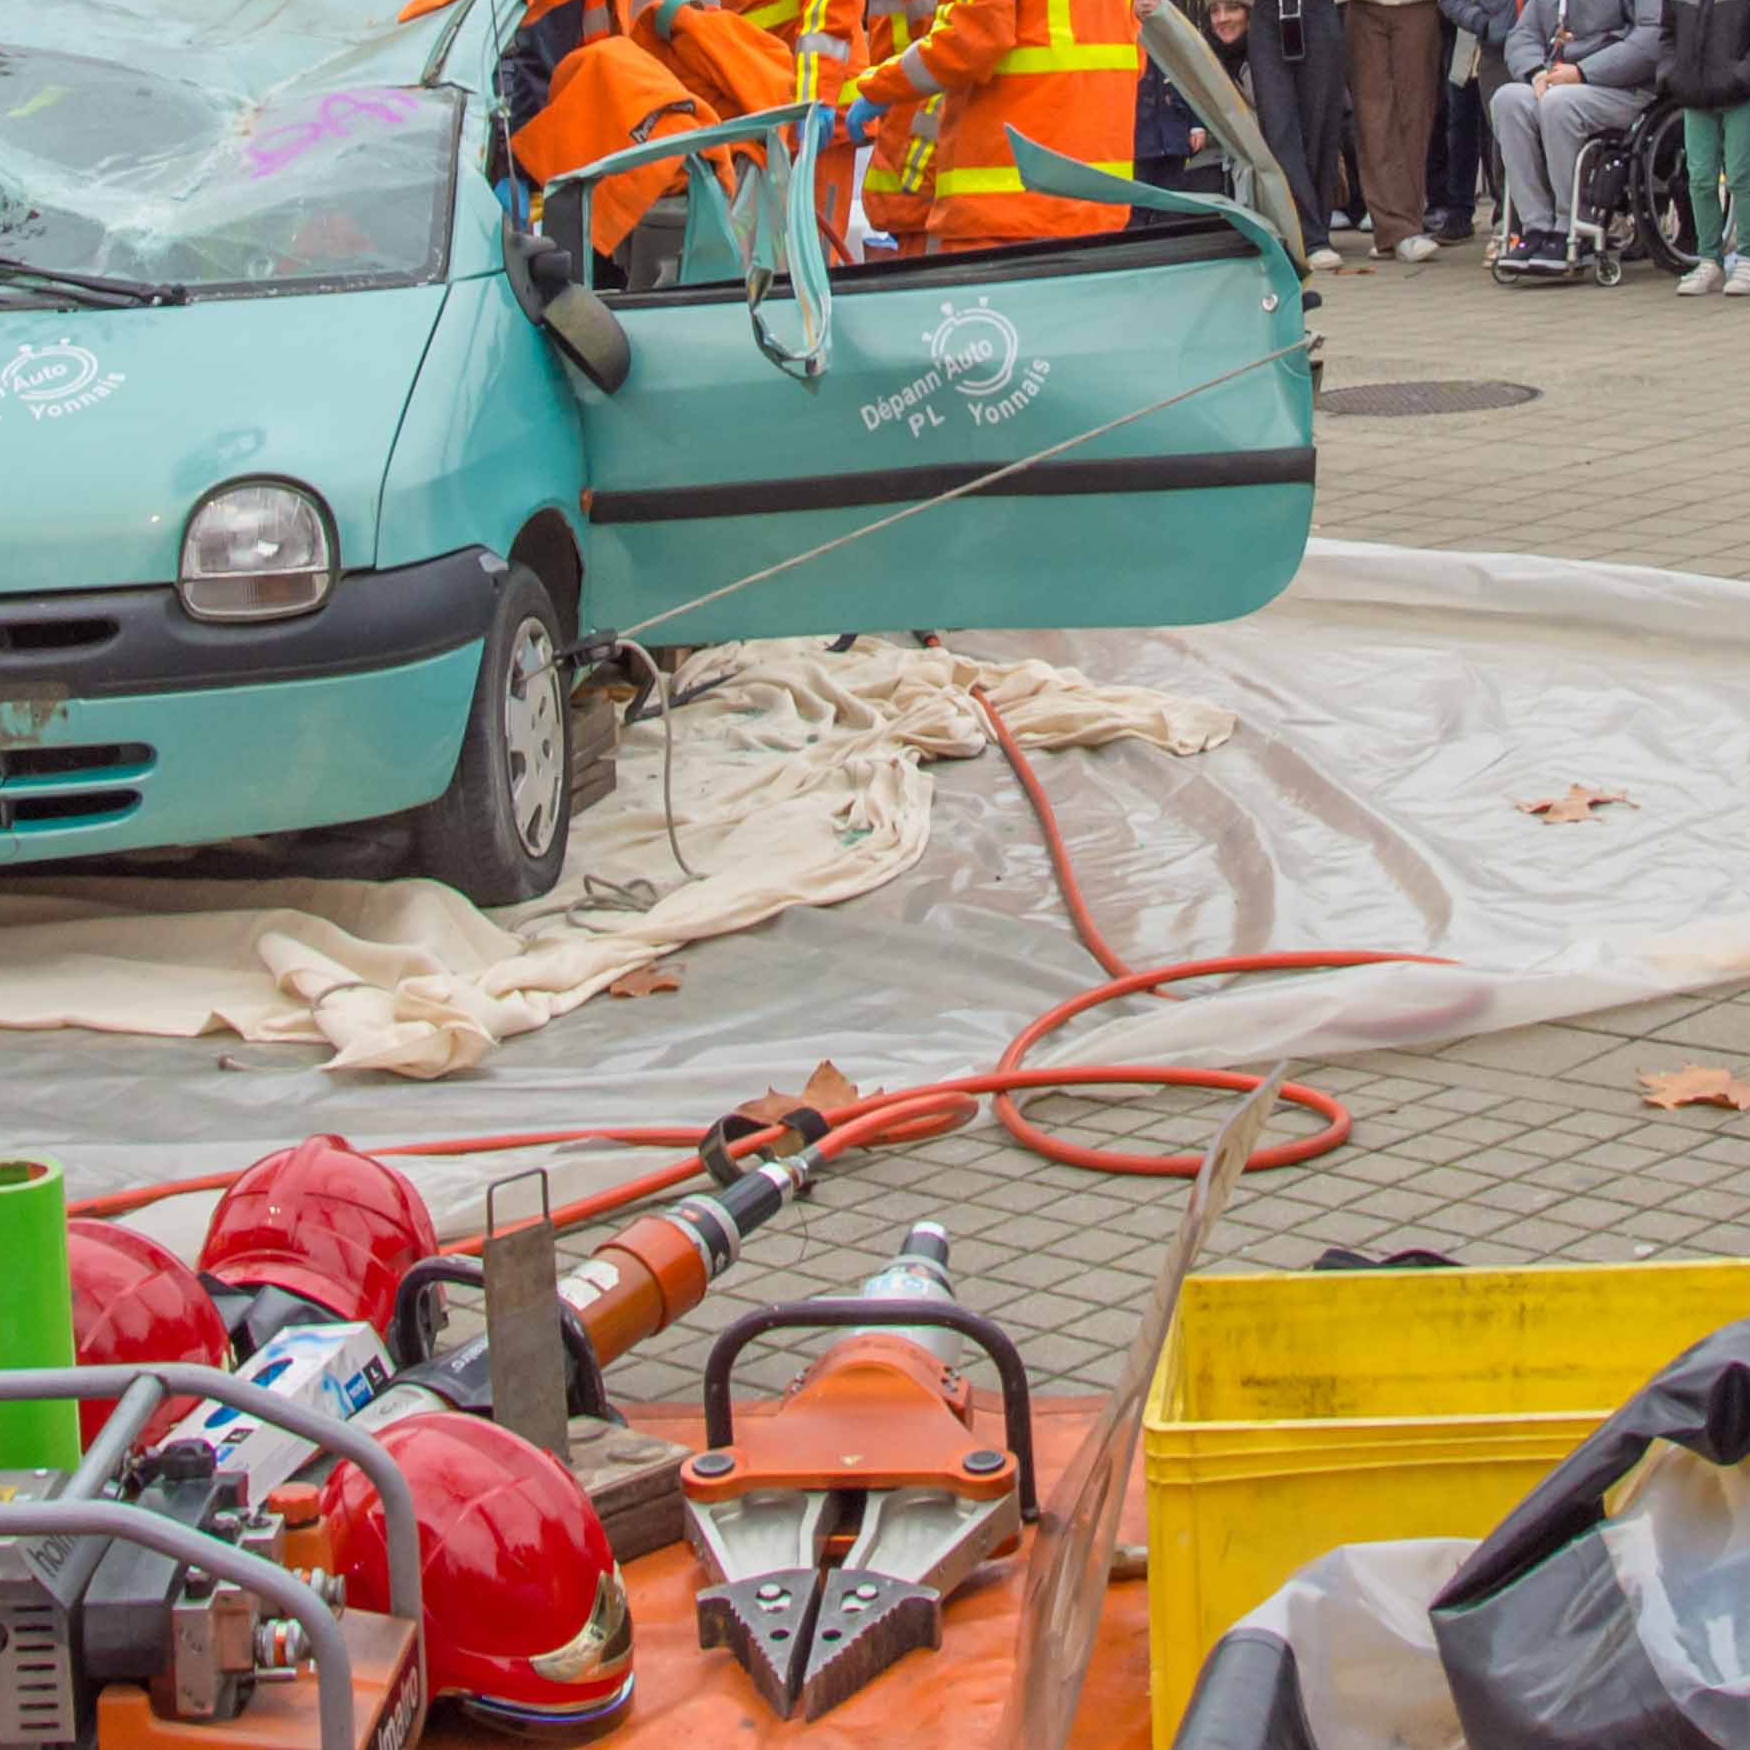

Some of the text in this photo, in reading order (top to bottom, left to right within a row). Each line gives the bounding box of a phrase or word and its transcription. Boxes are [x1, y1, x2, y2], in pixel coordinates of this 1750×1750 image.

[27, 371, 127, 421] Yonnais
[967, 356, 1052, 428] Yonnais
[906, 405, 947, 438] PL
